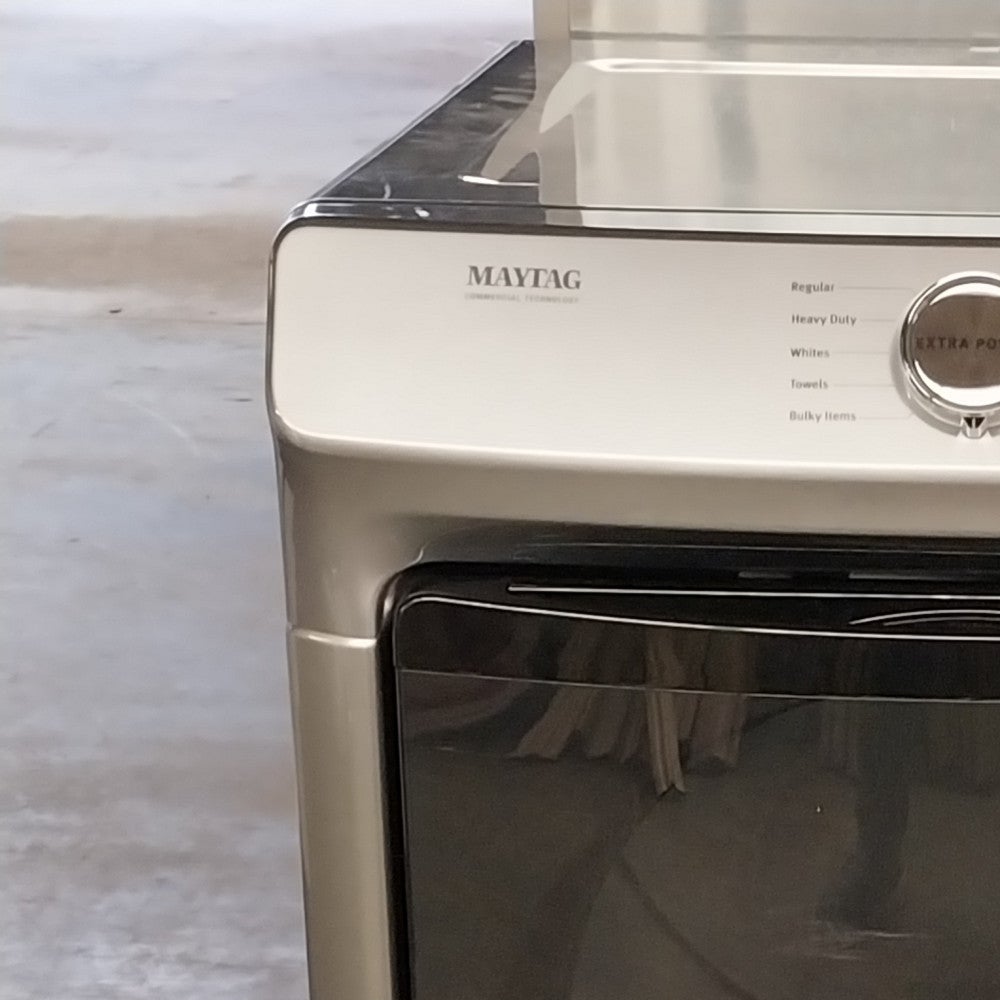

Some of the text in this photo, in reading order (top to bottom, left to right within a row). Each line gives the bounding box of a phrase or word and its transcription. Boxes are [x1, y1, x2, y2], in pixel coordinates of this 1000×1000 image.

[467, 265, 581, 290] MAYTAG
[791, 282, 835, 294] Regular
[791, 314, 857, 326] Heavy Duty
[916, 337, 969, 350] EXTRA
[790, 348, 830, 358] Whites
[791, 379, 829, 390] Towels
[789, 410, 857, 423] Bulky Items
